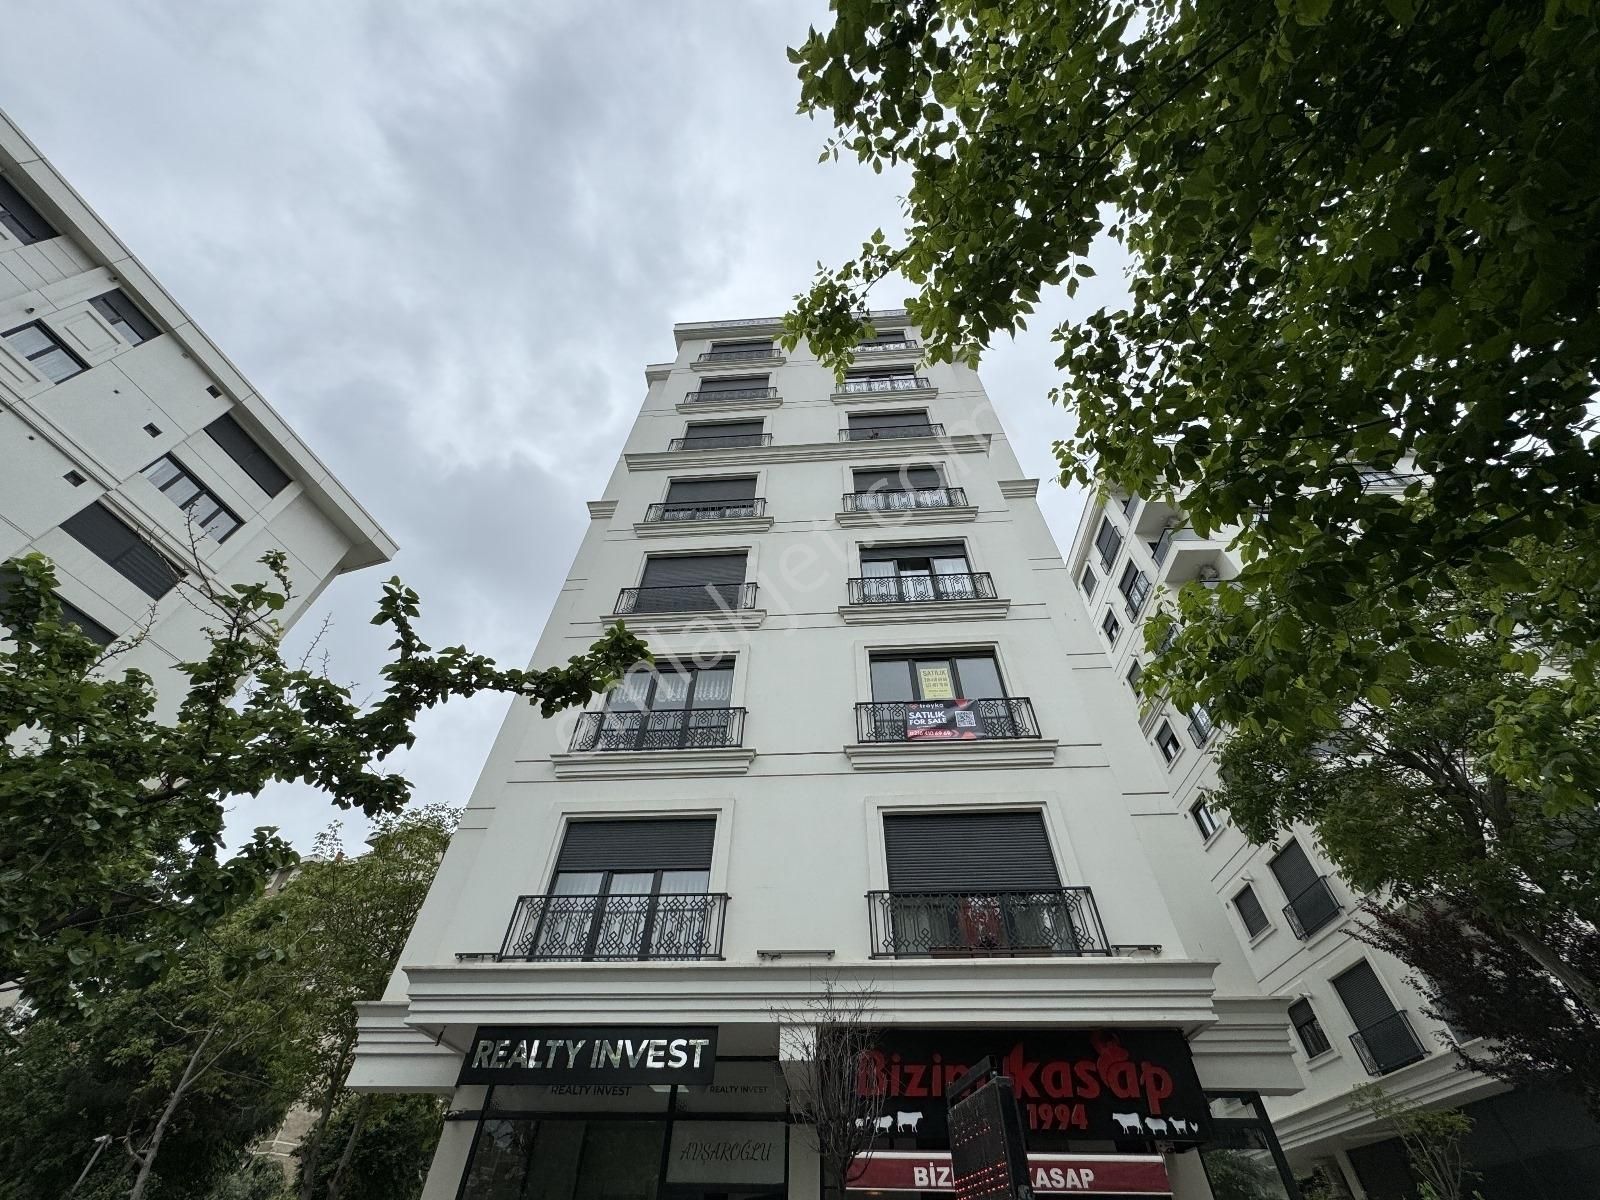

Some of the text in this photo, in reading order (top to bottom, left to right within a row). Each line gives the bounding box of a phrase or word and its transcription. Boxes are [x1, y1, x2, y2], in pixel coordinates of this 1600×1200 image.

[908, 711, 946, 719] SATILIK
[471, 1038, 710, 1069] REALTY INVEST
[551, 1085, 632, 1097] REALTY INVEST
[709, 1085, 768, 1094] REALTY INVEST
[1026, 1103, 1088, 1131] 1994
